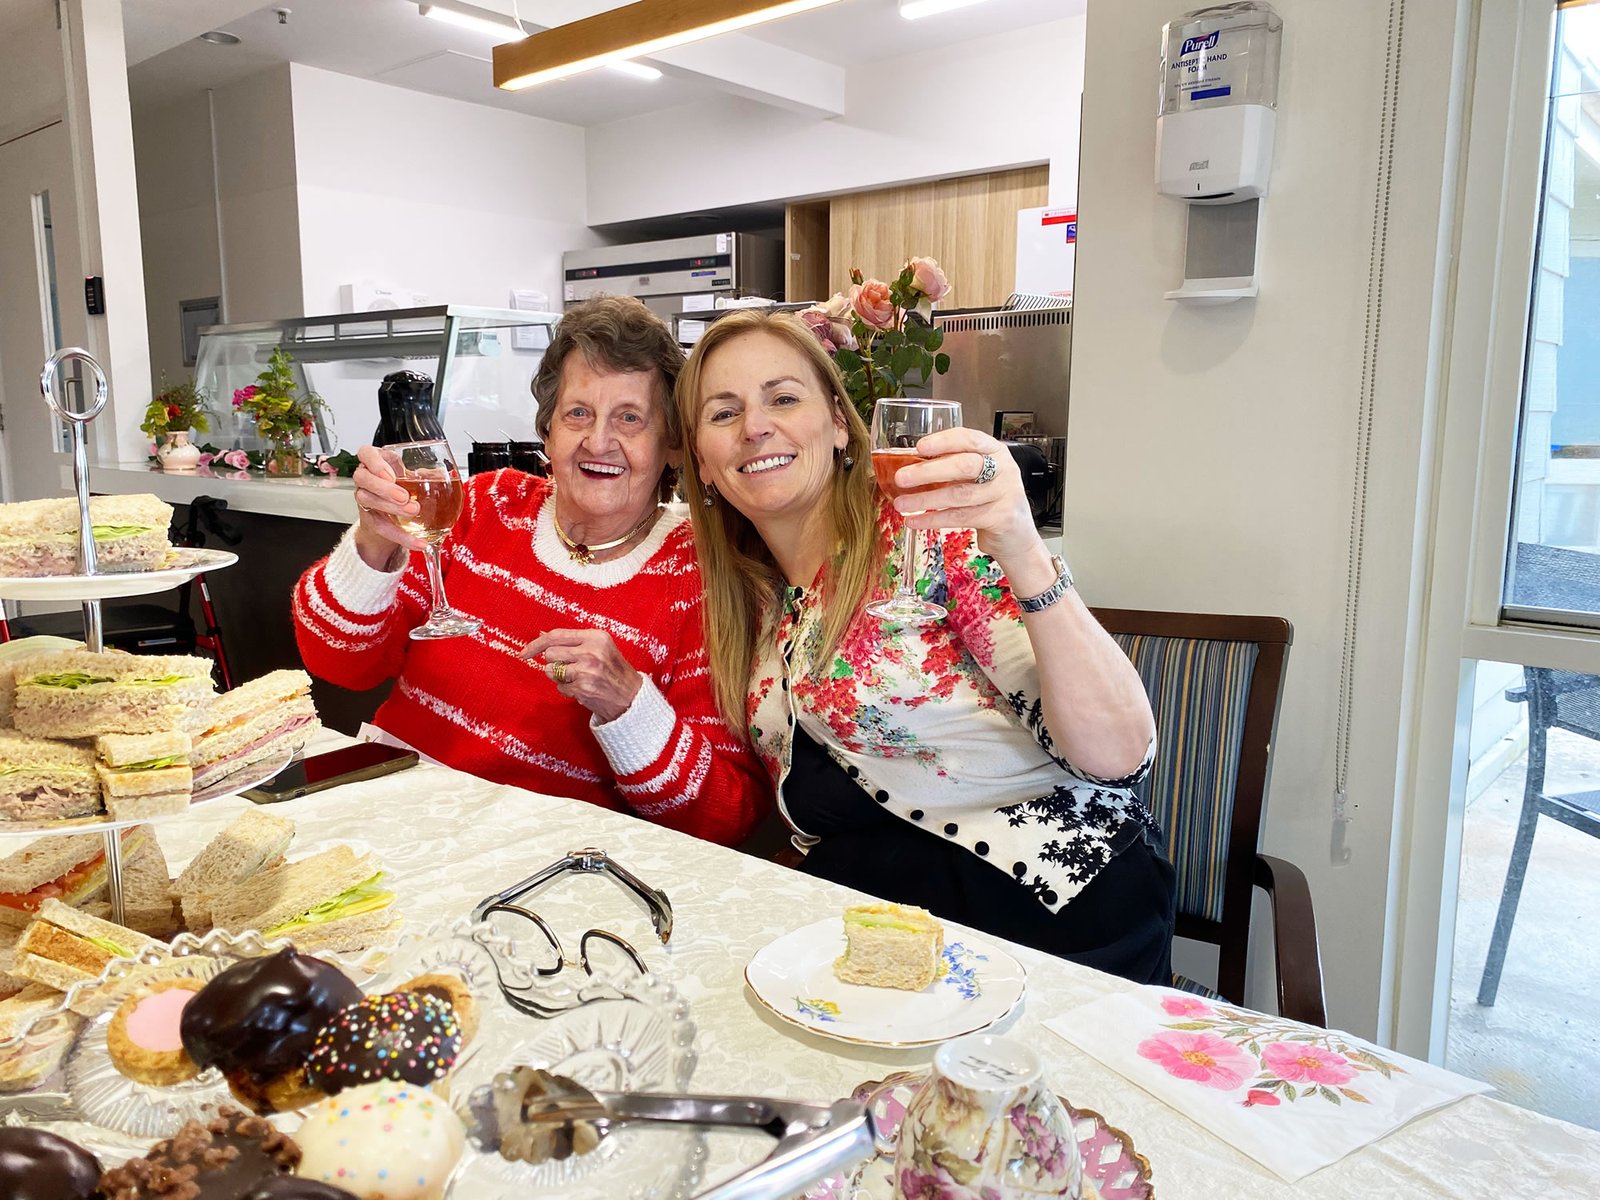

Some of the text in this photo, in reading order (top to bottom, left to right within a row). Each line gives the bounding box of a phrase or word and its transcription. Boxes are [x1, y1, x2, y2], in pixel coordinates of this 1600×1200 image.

[1185, 35, 1216, 52] Purell
[1171, 53, 1228, 70] ANTISEPTC HAND
